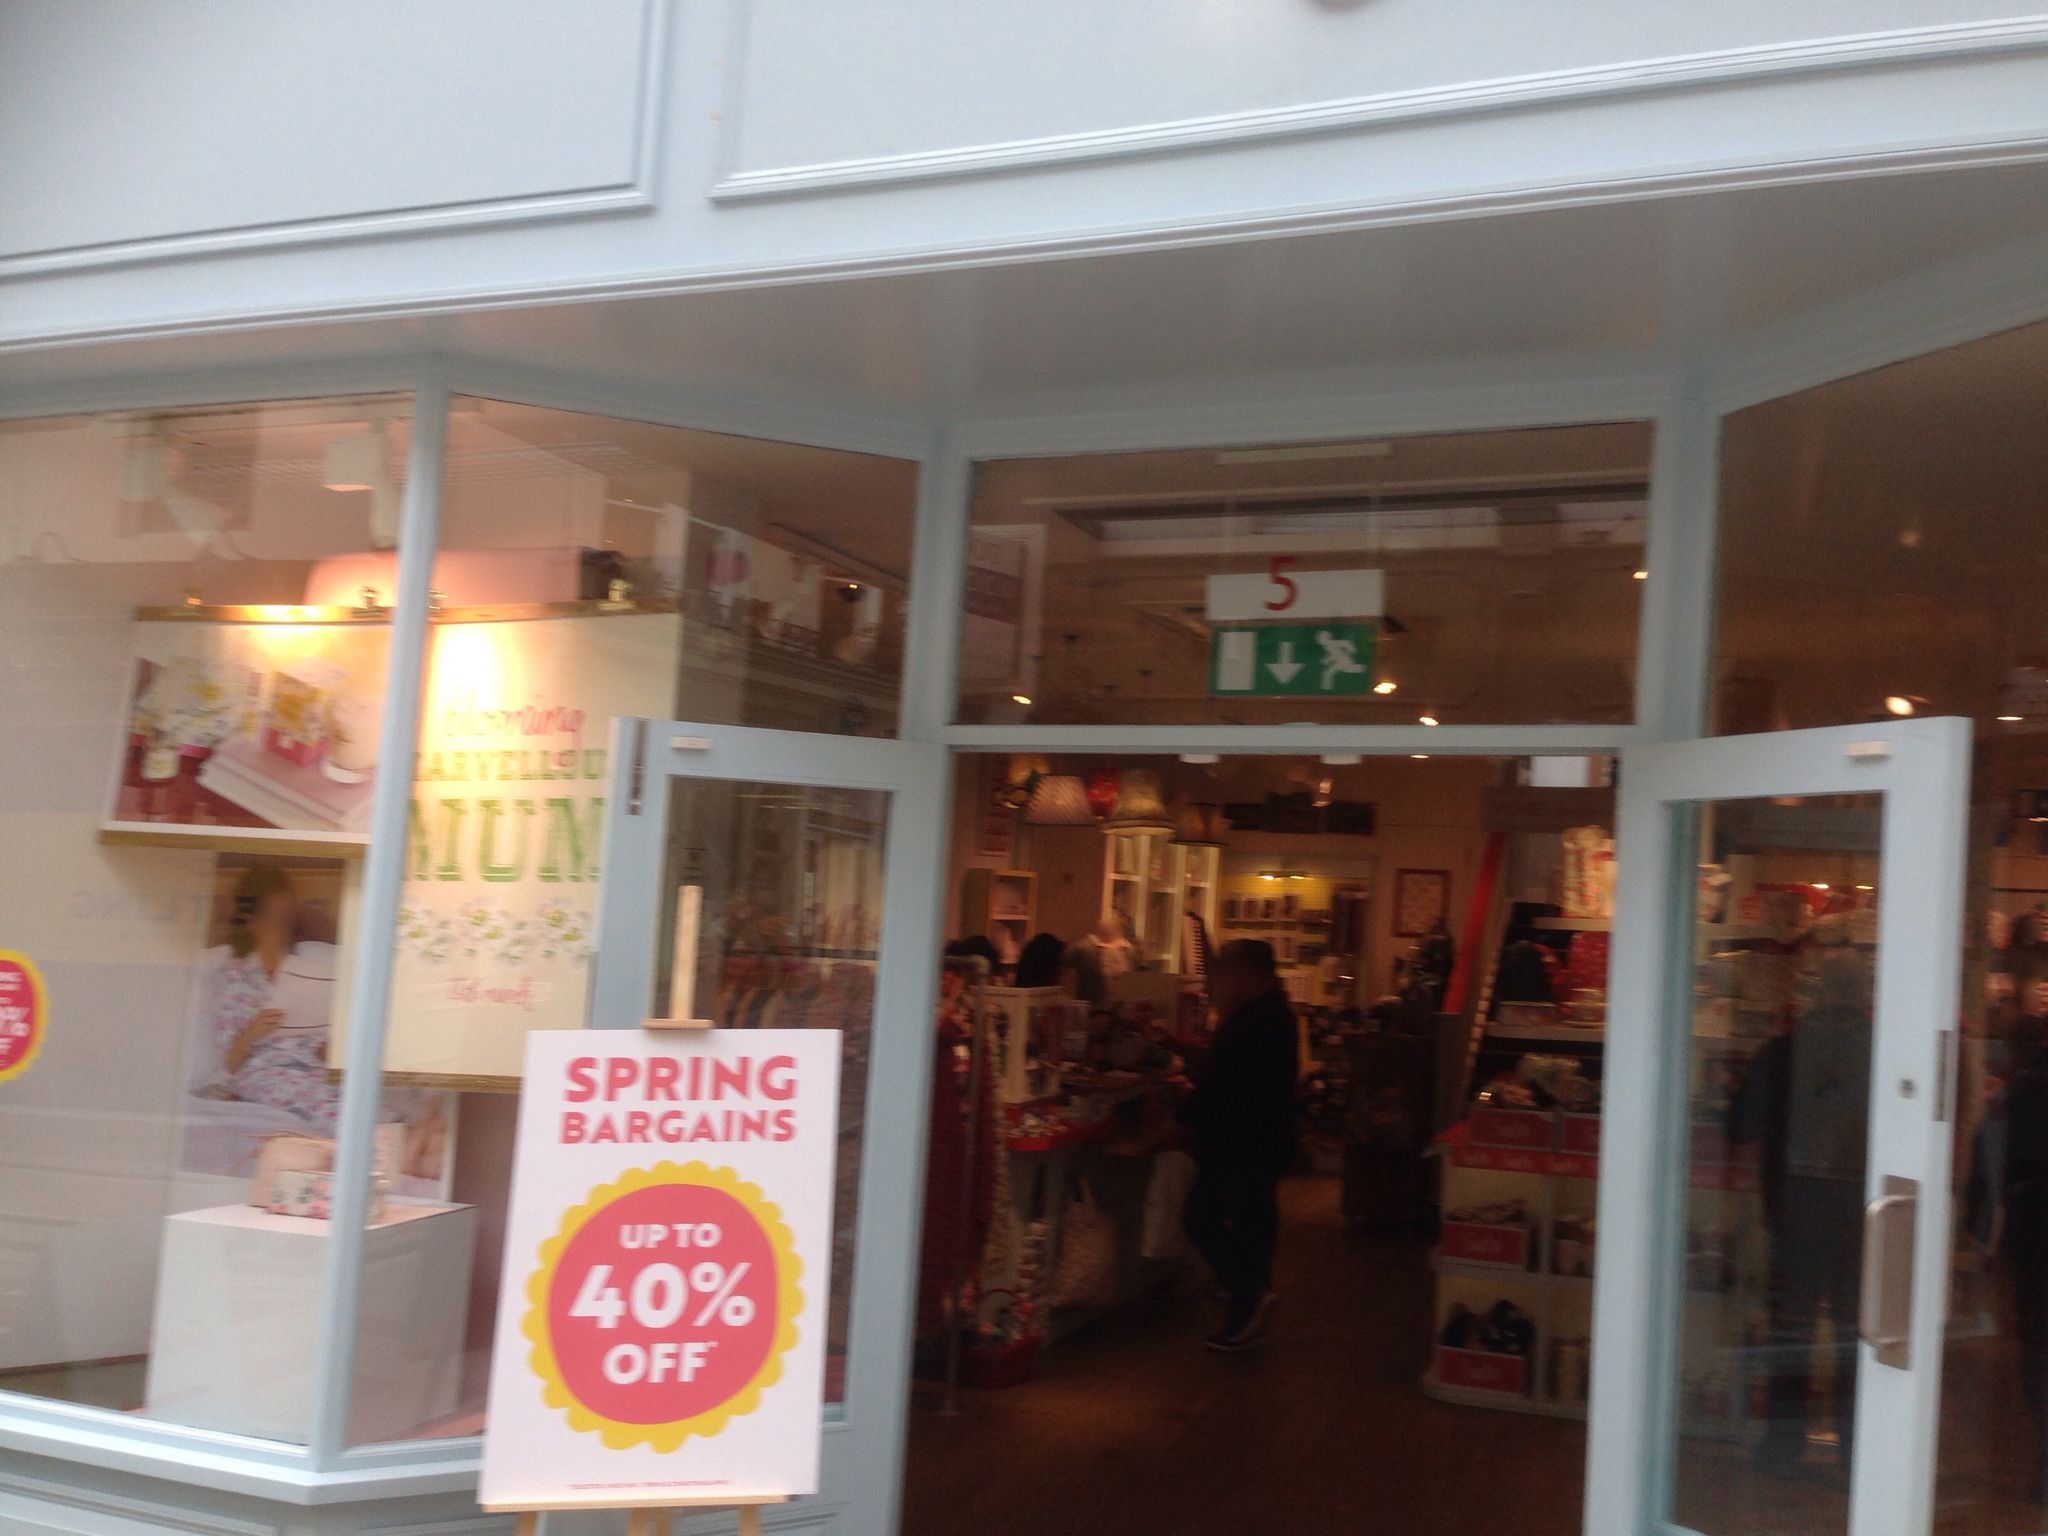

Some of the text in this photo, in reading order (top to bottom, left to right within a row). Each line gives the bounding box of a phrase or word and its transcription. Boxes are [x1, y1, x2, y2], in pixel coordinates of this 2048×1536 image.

[1265, 556, 1297, 611] 5
[564, 1056, 798, 1102] SPRING
[558, 1109, 798, 1144] BARGAINS
[619, 1222, 722, 1249] UP TO
[568, 1261, 757, 1330] 40%
